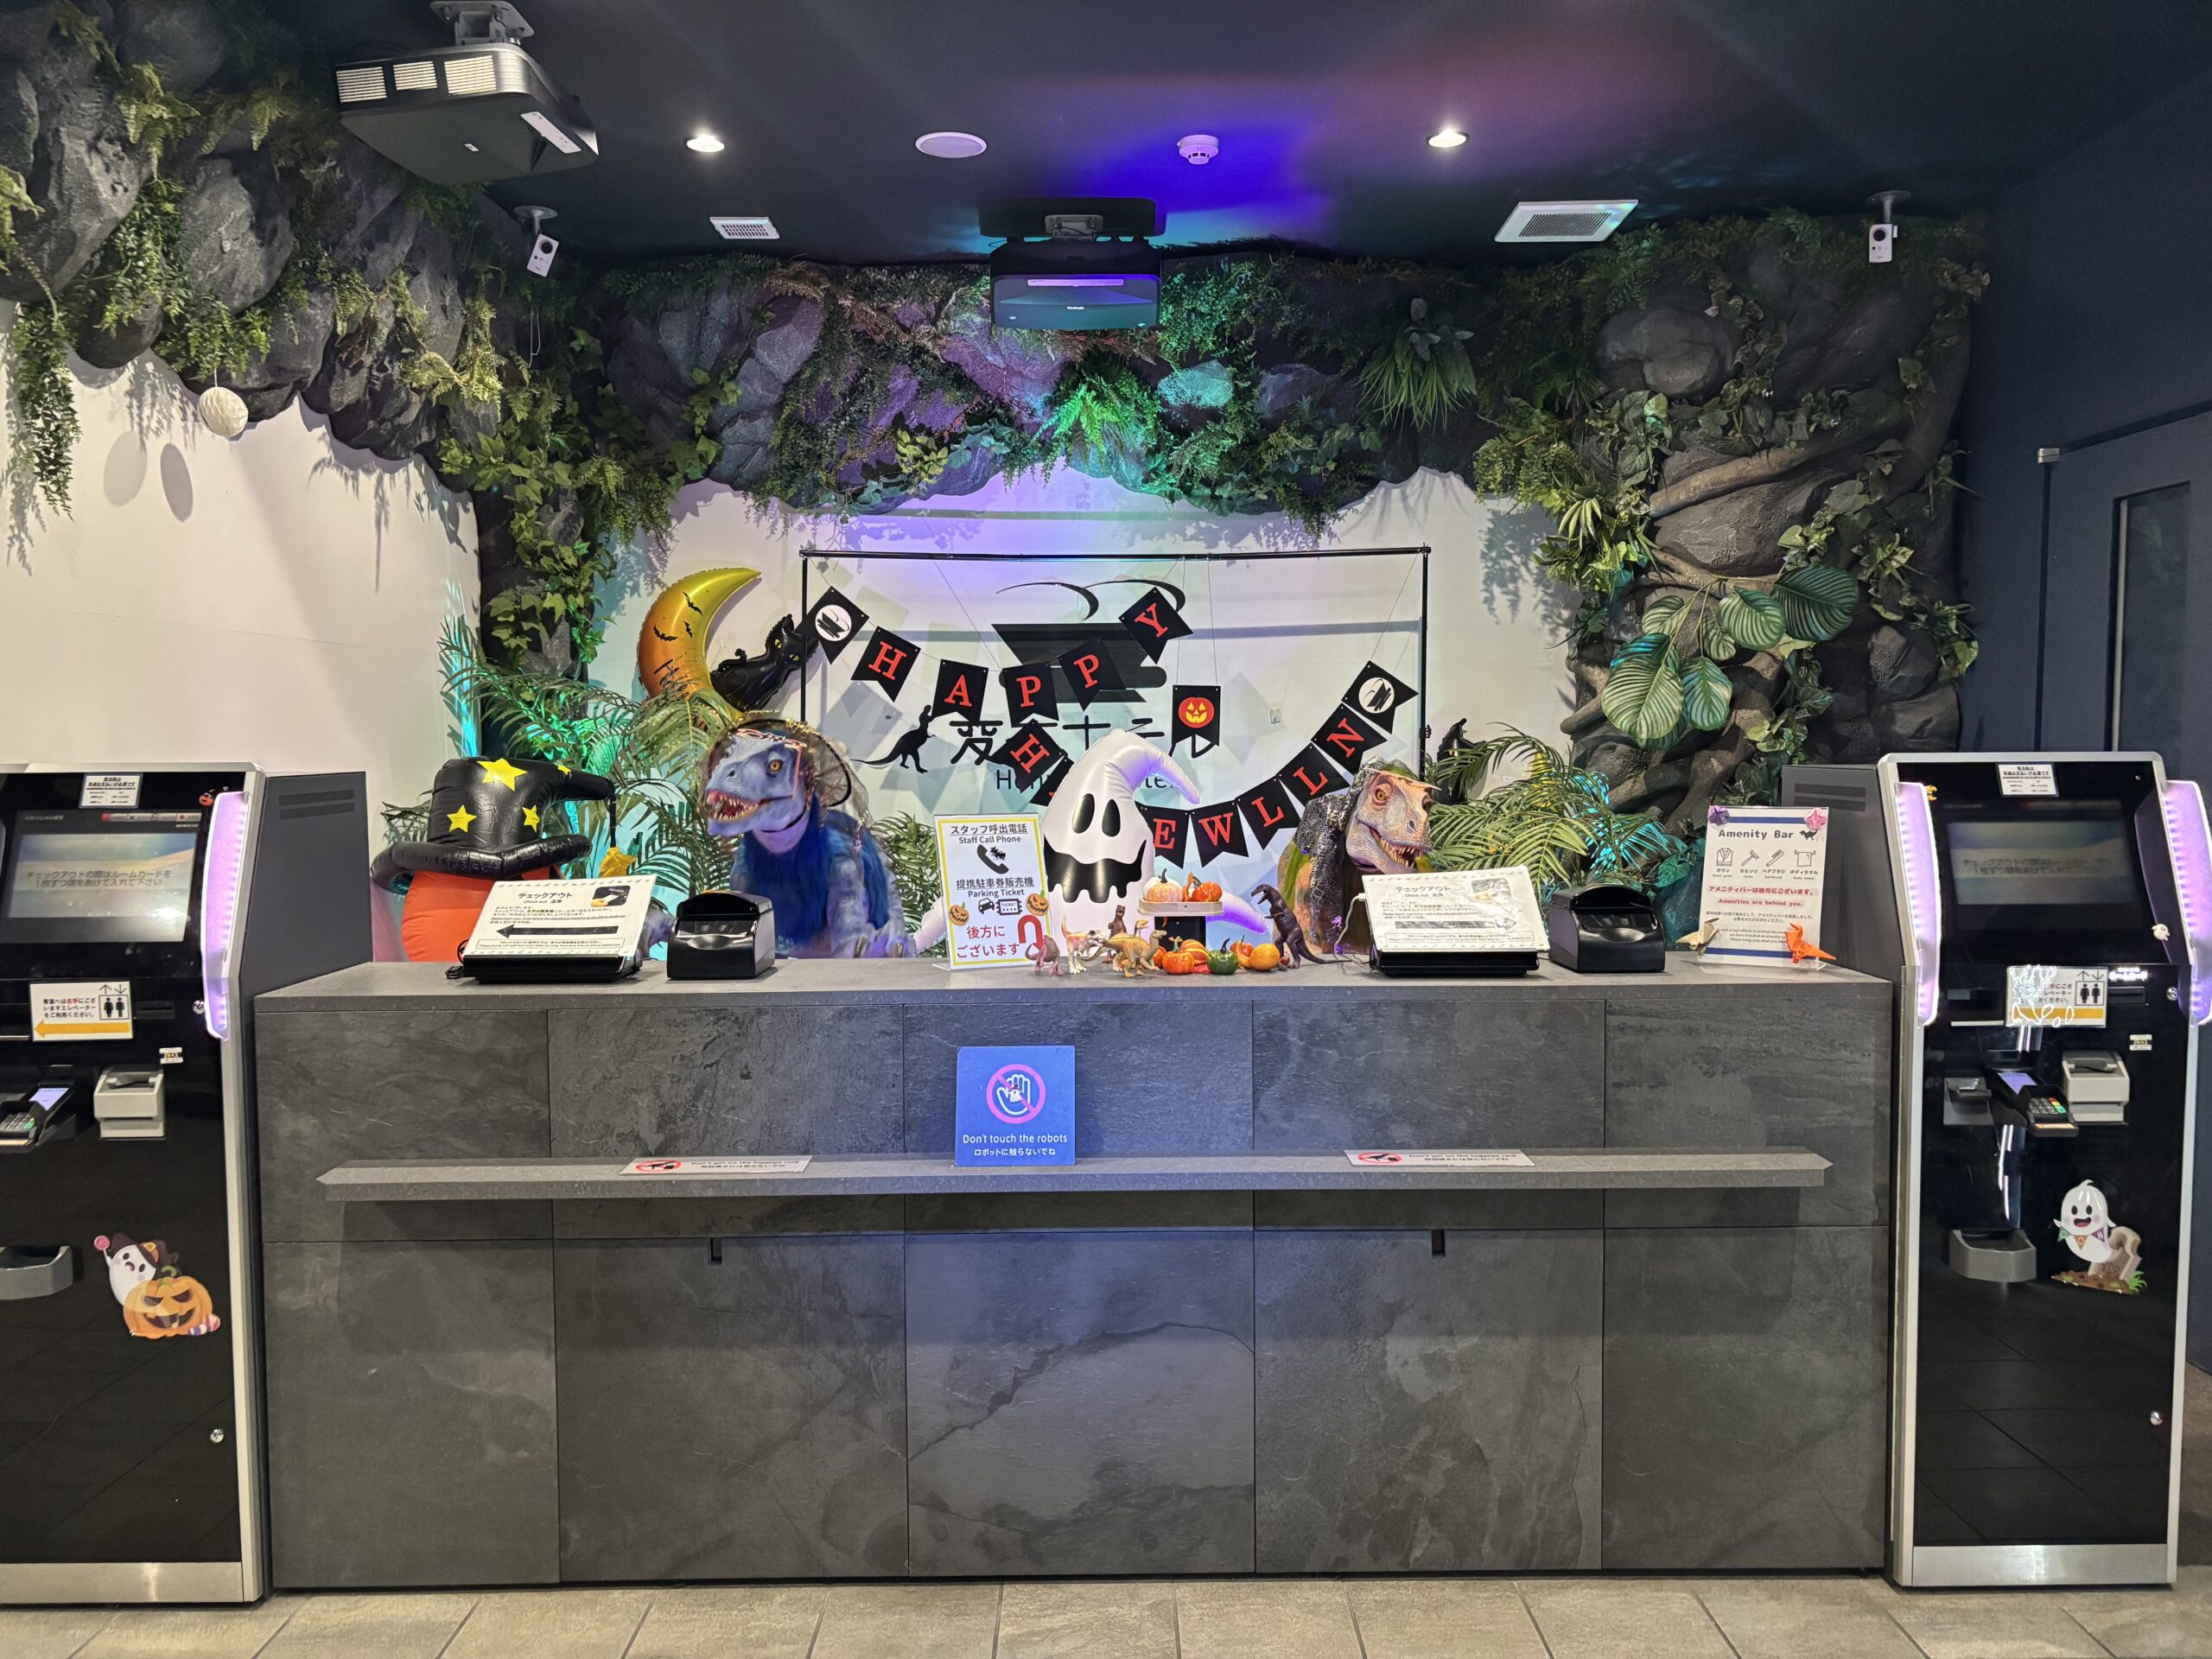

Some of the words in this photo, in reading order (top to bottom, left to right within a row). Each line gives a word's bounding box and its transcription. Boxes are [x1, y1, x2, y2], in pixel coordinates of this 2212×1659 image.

[868, 603, 1169, 709] HAPPY
[950, 823, 1027, 836] スタッフ呼出電話
[1718, 830, 1767, 841] Amenity
[1774, 830, 1795, 839] Bar
[956, 876, 1034, 889] 提携駐車券販売機
[968, 890, 999, 899] Parking
[967, 925, 1006, 939] 後方に
[957, 943, 1020, 958] ございます
[963, 1134, 987, 1144] Don't
[989, 1134, 1016, 1143] touch
[1019, 1134, 1034, 1142] the
[1037, 1134, 1067, 1142] robots
[974, 1147, 1056, 1156] ロボットに触らないでね
